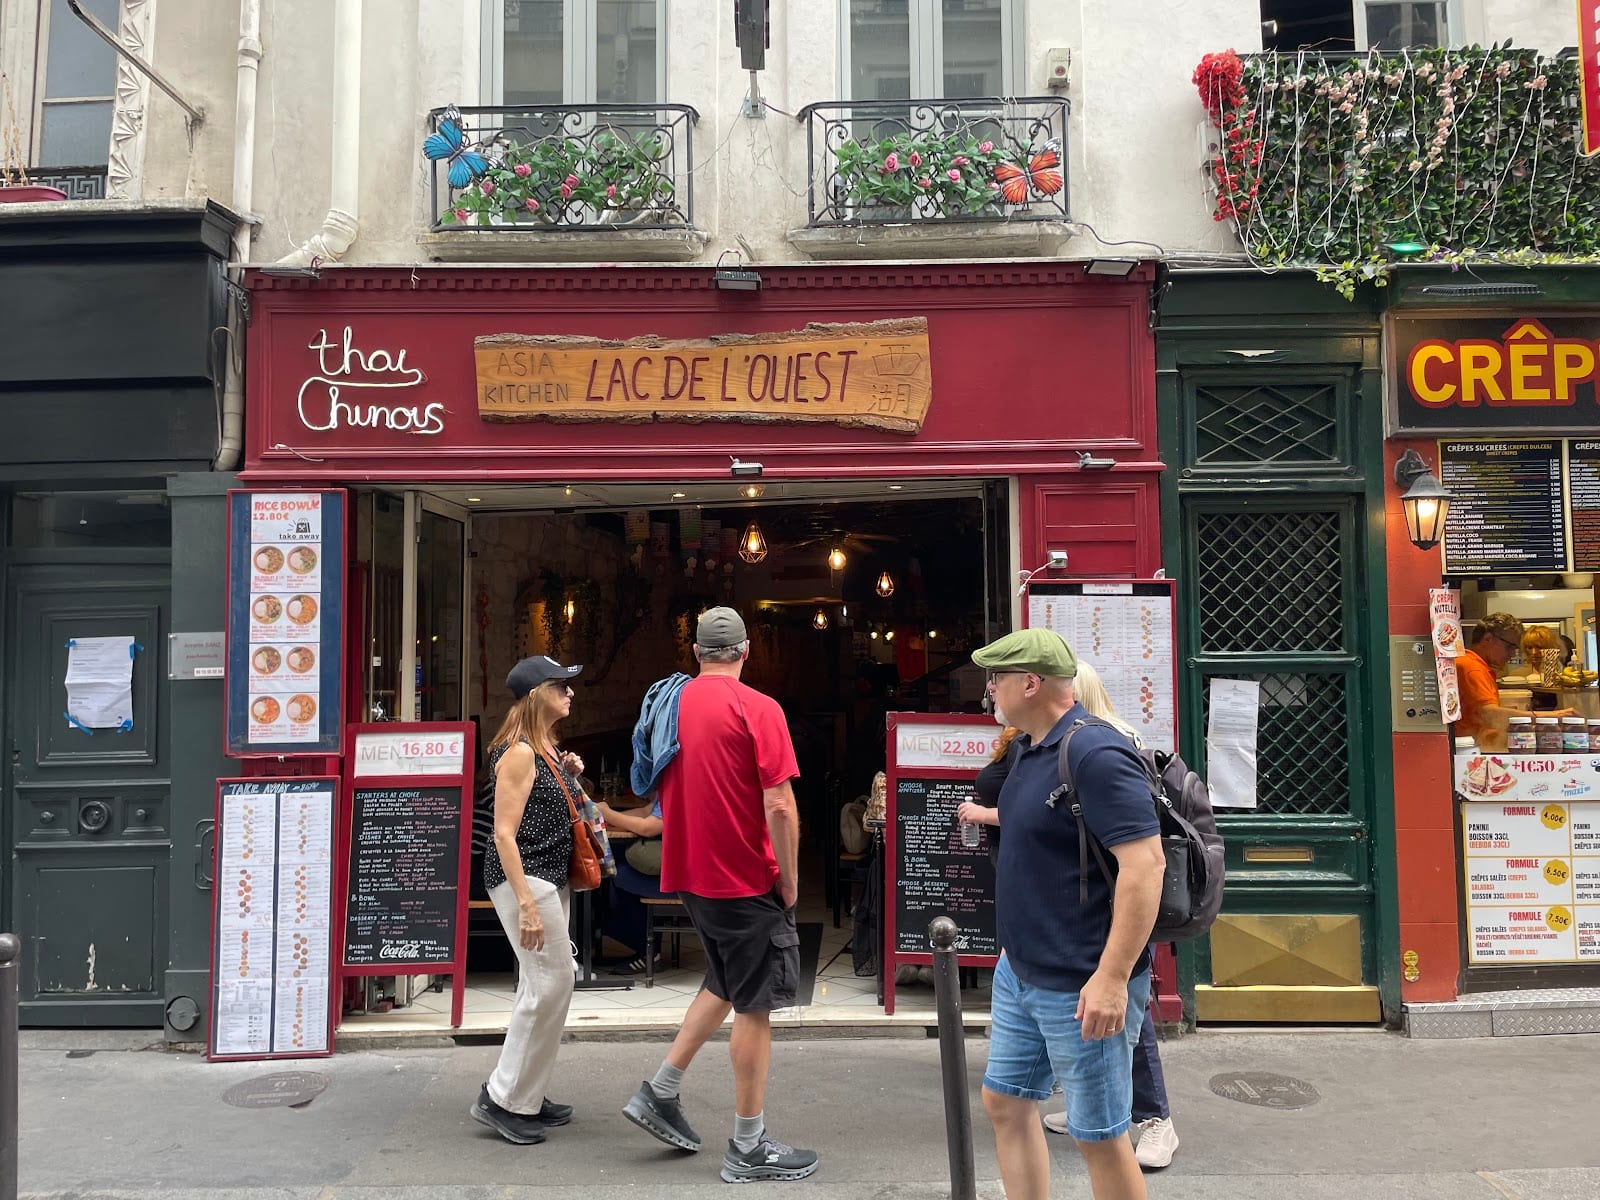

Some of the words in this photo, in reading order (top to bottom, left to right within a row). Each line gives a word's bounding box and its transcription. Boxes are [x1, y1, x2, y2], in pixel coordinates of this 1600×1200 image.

[308, 326, 422, 376] thai
[497, 351, 556, 377] ASIA
[1411, 324, 1600, 403] CRÊP
[585, 356, 653, 402] LAC
[661, 356, 710, 401] DE
[720, 350, 858, 403] L'OUEST
[484, 383, 570, 405] KITCHEN
[298, 377, 444, 434] Chinois
[1447, 444, 1473, 452] CRÊPES
[254, 501, 279, 511] RICE
[1434, 604, 1458, 615] NUTELLA
[402, 742, 444, 757] 16,80
[449, 742, 459, 754] €
[902, 735, 942, 752] MEN
[943, 740, 986, 756] 22,80
[991, 739, 1000, 751] €
[361, 745, 408, 761] MEN
[229, 783, 260, 796] TAKE
[263, 782, 291, 794] AWAY
[1503, 806, 1536, 816] FORMULE
[1506, 859, 1539, 868] FORMULE
[1489, 873, 1507, 881] SALÉES
[1509, 912, 1542, 921] FORMULE
